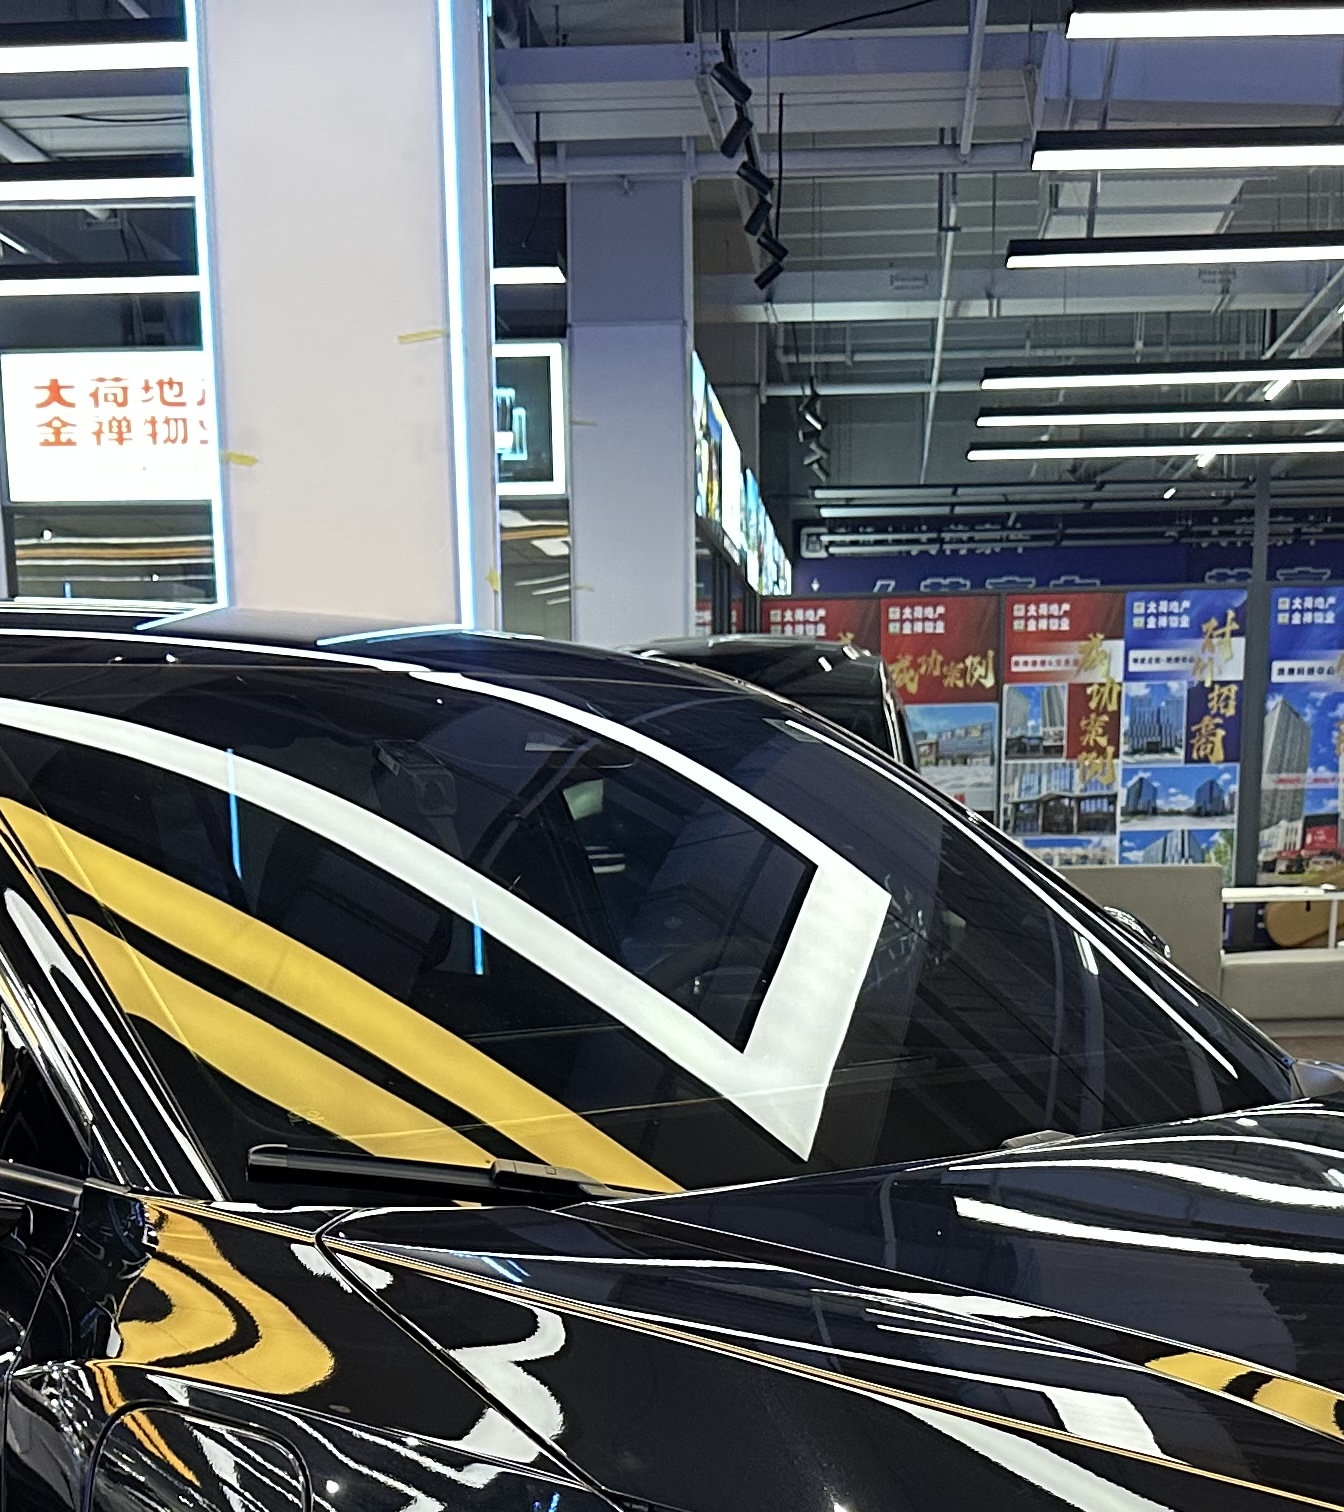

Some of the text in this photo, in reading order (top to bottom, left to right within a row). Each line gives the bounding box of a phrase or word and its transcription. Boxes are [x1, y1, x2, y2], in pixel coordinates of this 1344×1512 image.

[33, 376, 207, 409] 大荷地
[36, 415, 209, 447] 金禅物
